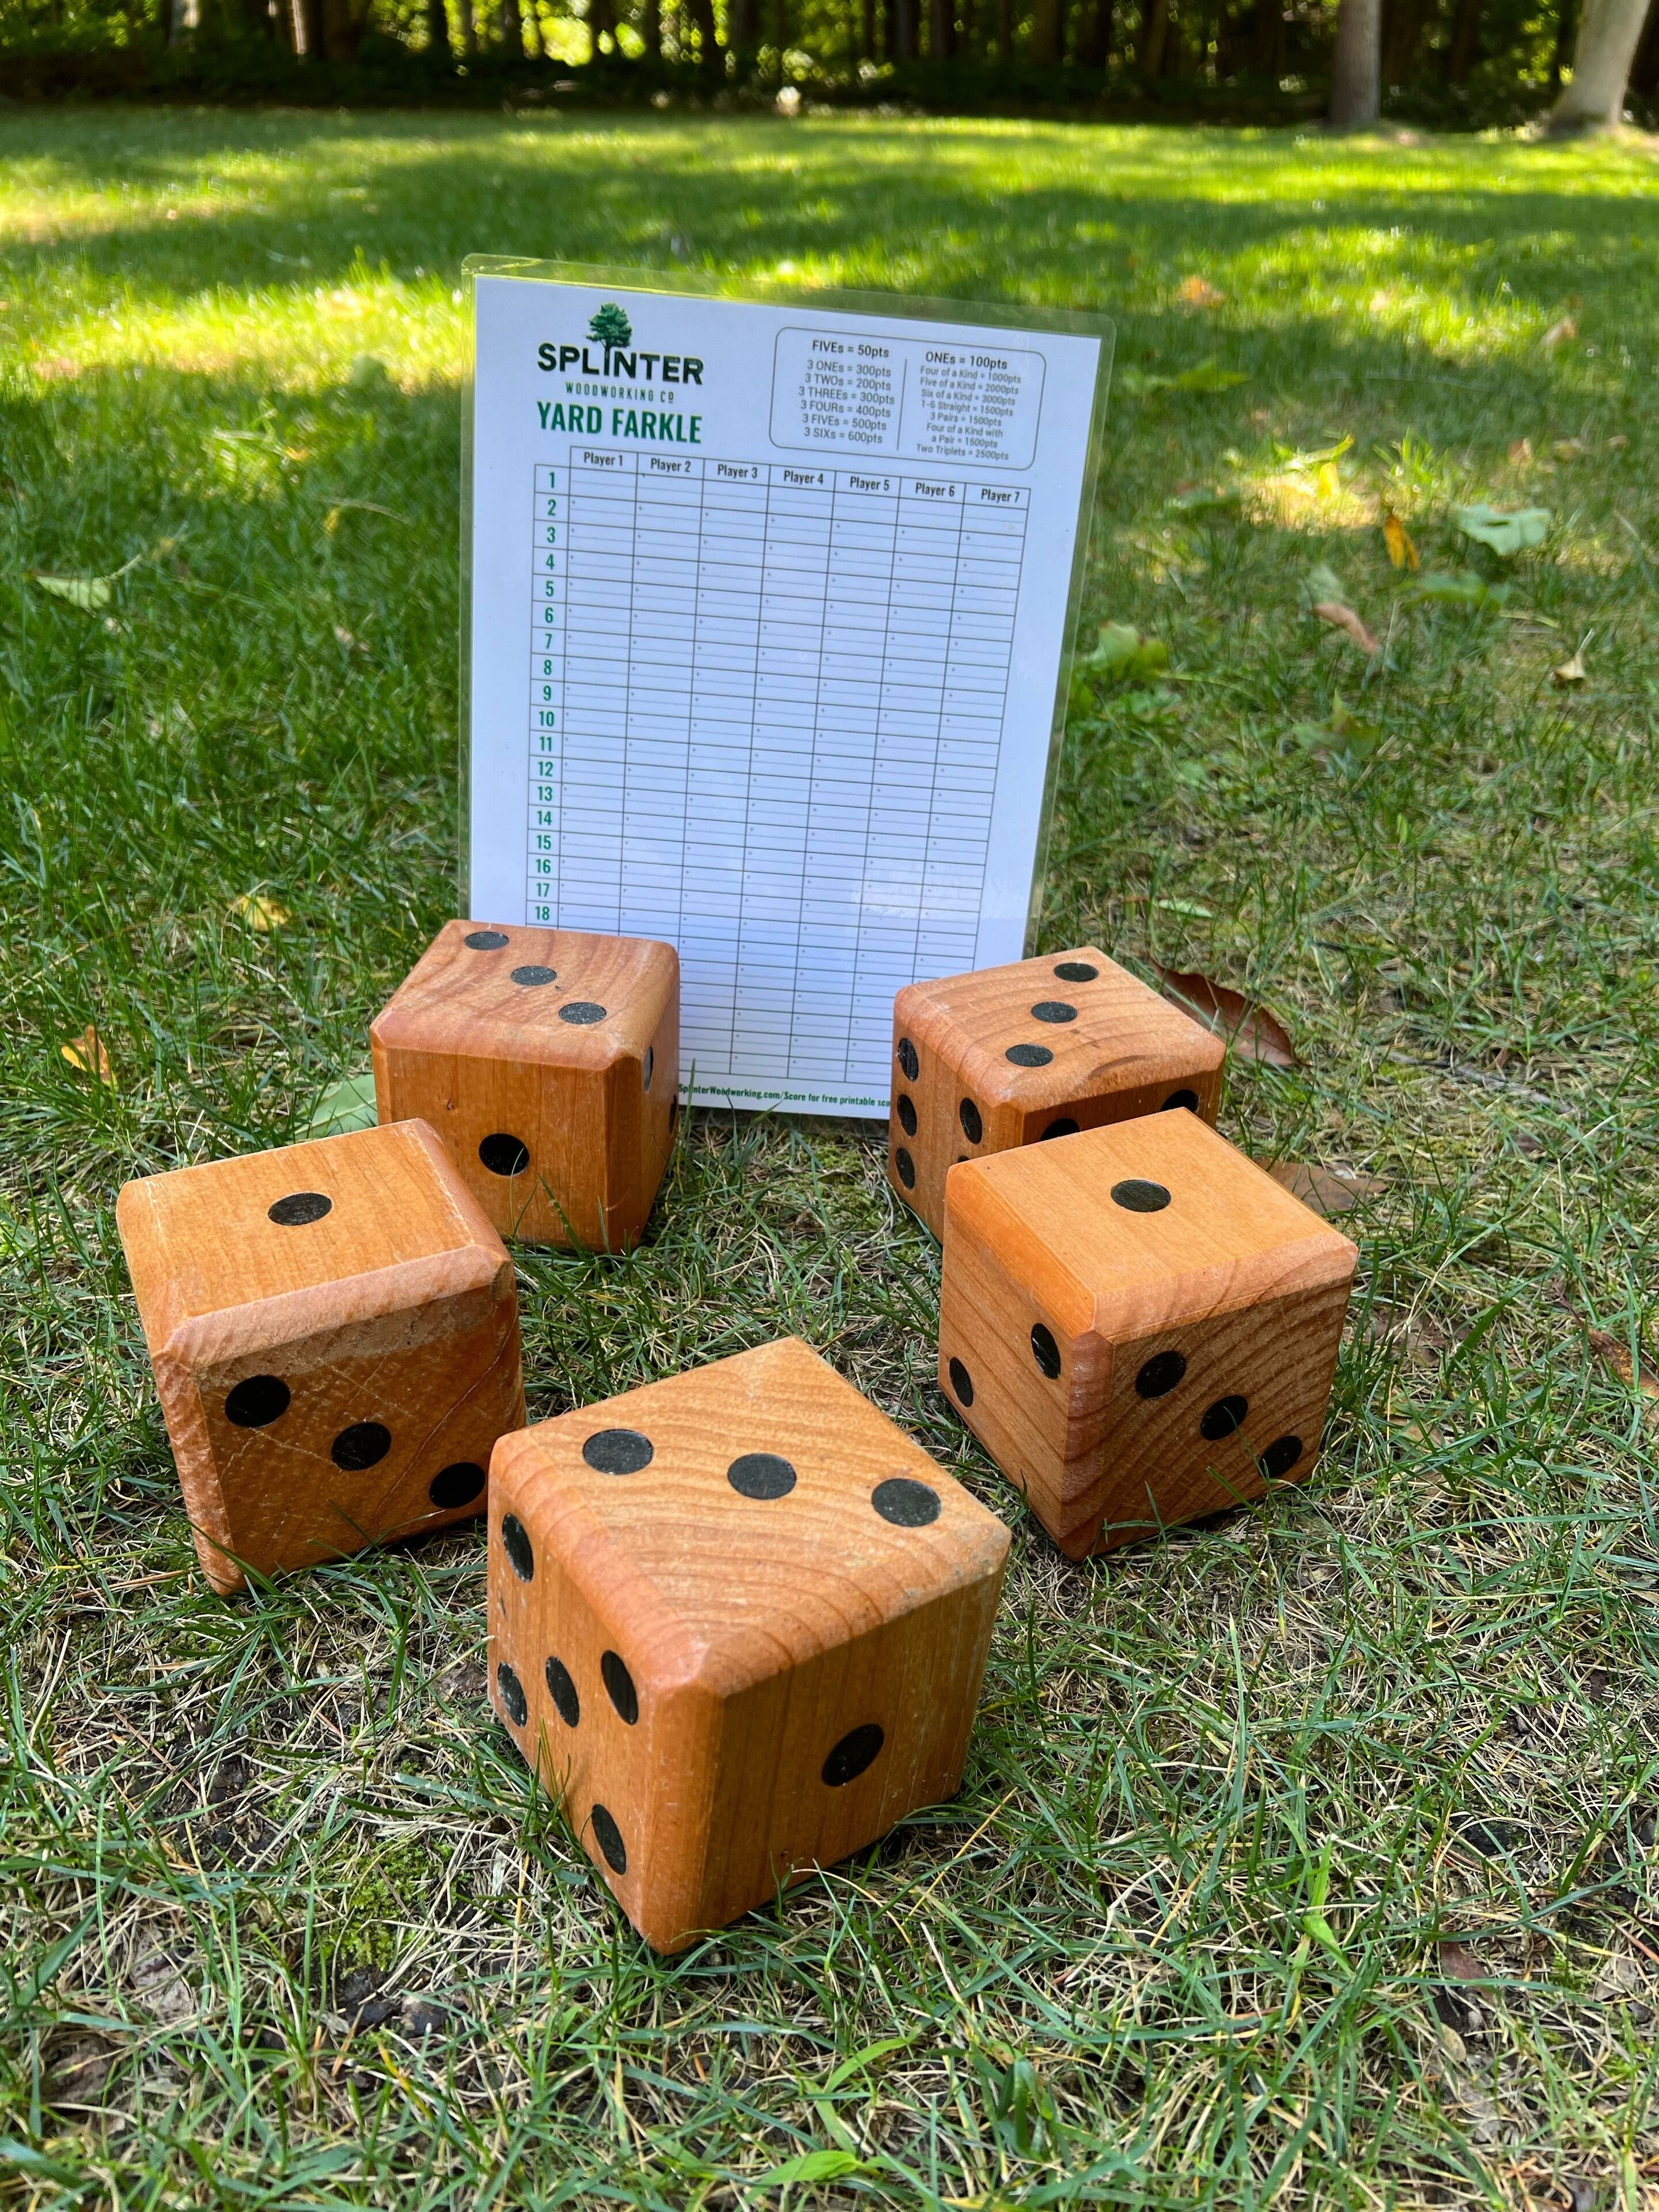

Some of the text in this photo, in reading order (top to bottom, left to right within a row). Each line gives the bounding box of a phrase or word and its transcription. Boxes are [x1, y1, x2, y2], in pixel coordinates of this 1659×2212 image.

[812, 340, 843, 353] FIVEs
[858, 344, 889, 358] 50pts
[537, 342, 704, 385] SPLINTER
[808, 359, 813, 369] 3
[816, 361, 844, 372] ONEs
[857, 364, 891, 377] 300pts
[926, 351, 955, 364] ONEs
[971, 355, 1007, 370] 100pts
[805, 373, 811, 382] 3
[815, 374, 844, 385] TWOs
[857, 378, 891, 391] 200pts
[921, 366, 938, 374] Four
[941, 368, 950, 376] of
[959, 370, 978, 379] Kind
[988, 372, 1021, 384] 1000pts
[566, 381, 653, 401] WOODWORKING
[920, 377, 937, 386] Five
[939, 379, 948, 387] of
[957, 381, 976, 390] Kind
[986, 384, 1019, 395] 2000pts
[798, 386, 804, 396] 3
[809, 387, 847, 399] THREEs
[860, 392, 895, 405] 300pts
[922, 389, 933, 397] Six
[936, 390, 944, 399] of
[954, 392, 972, 401] Kind
[982, 395, 1015, 406] 3000pts
[801, 400, 806, 409] 3
[810, 401, 844, 412] FOURs
[857, 406, 891, 418] 400pts
[922, 400, 935, 408] 1-6
[938, 402, 970, 413] Straight
[981, 406, 1013, 416] 1500pts
[537, 401, 702, 444] YARD FARKLE
[802, 414, 808, 423] 3
[812, 414, 839, 426] FIVEs
[852, 418, 887, 431] 500pts
[930, 412, 935, 420] 3
[938, 413, 959, 422] Pairs
[969, 416, 1002, 427] 1500pts
[804, 427, 810, 436] 3
[813, 428, 835, 439] SIXs
[848, 431, 882, 444] 600pts
[927, 423, 944, 431] Four
[947, 425, 956, 433] of
[965, 427, 983, 435] Kind
[986, 429, 1003, 438] with
[939, 434, 955, 443] Pair
[965, 437, 998, 448] 1500pts
[584, 452, 623, 466] Player 1
[916, 444, 933, 453] Two
[936, 446, 965, 456] Triplets
[976, 450, 1009, 460] 2500pts
[651, 458, 691, 473] Player 2
[717, 464, 757, 479] Player 3
[549, 471, 555, 488] 1
[783, 470, 824, 485] Player 4
[849, 476, 890, 491] Player 5
[915, 482, 955, 497] Player 6
[981, 488, 1020, 503] Player 7
[547, 499, 556, 516] 2
[547, 526, 556, 544] 3
[546, 554, 555, 570] 4
[546, 580, 554, 597] 5
[545, 607, 554, 623] 6
[545, 633, 552, 649] 7
[543, 659, 552, 676] 8
[542, 684, 552, 701] 9
[539, 711, 555, 727] 10
[539, 736, 552, 752] 11
[538, 761, 554, 777] 12
[537, 786, 552, 802] 13
[537, 810, 552, 826] 14
[536, 835, 551, 850] 15
[536, 858, 551, 874] 16
[536, 882, 550, 897] 17
[535, 906, 550, 921] 18
[679, 1084, 806, 1101] SplnterWoodworking.com/Score
[808, 1093, 820, 1103] for
[821, 1093, 838, 1104] free
[839, 1096, 875, 1107] printable
